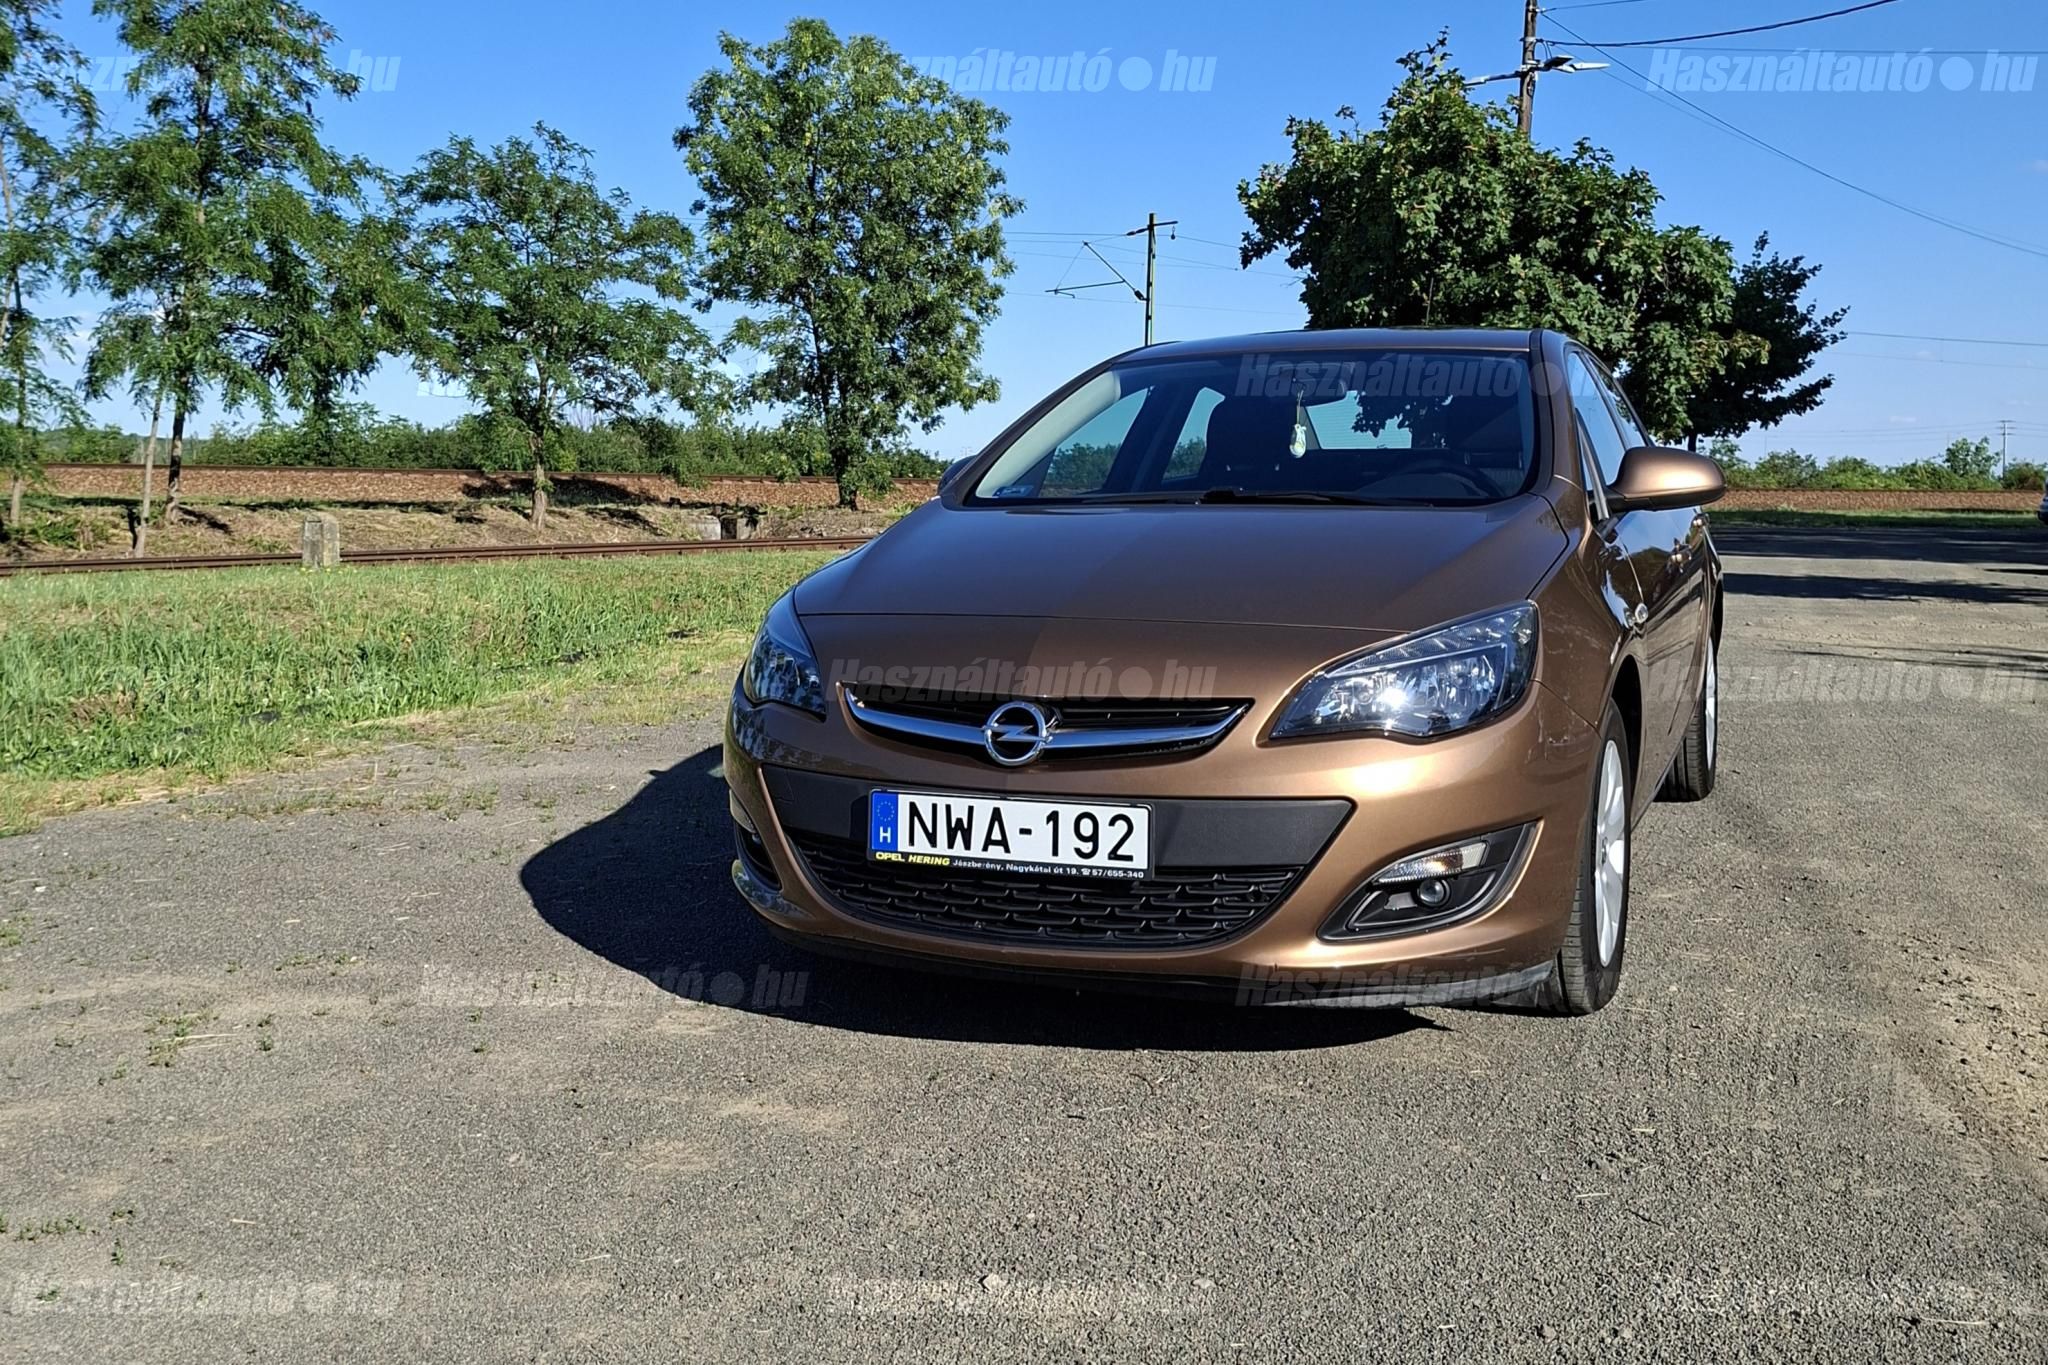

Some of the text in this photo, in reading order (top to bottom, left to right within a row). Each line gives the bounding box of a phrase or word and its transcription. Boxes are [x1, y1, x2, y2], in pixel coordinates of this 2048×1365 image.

[879, 826, 891, 843] H
[907, 801, 1134, 862] NWA-192
[875, 851, 905, 862] OPEL
[908, 854, 950, 866] HERING
